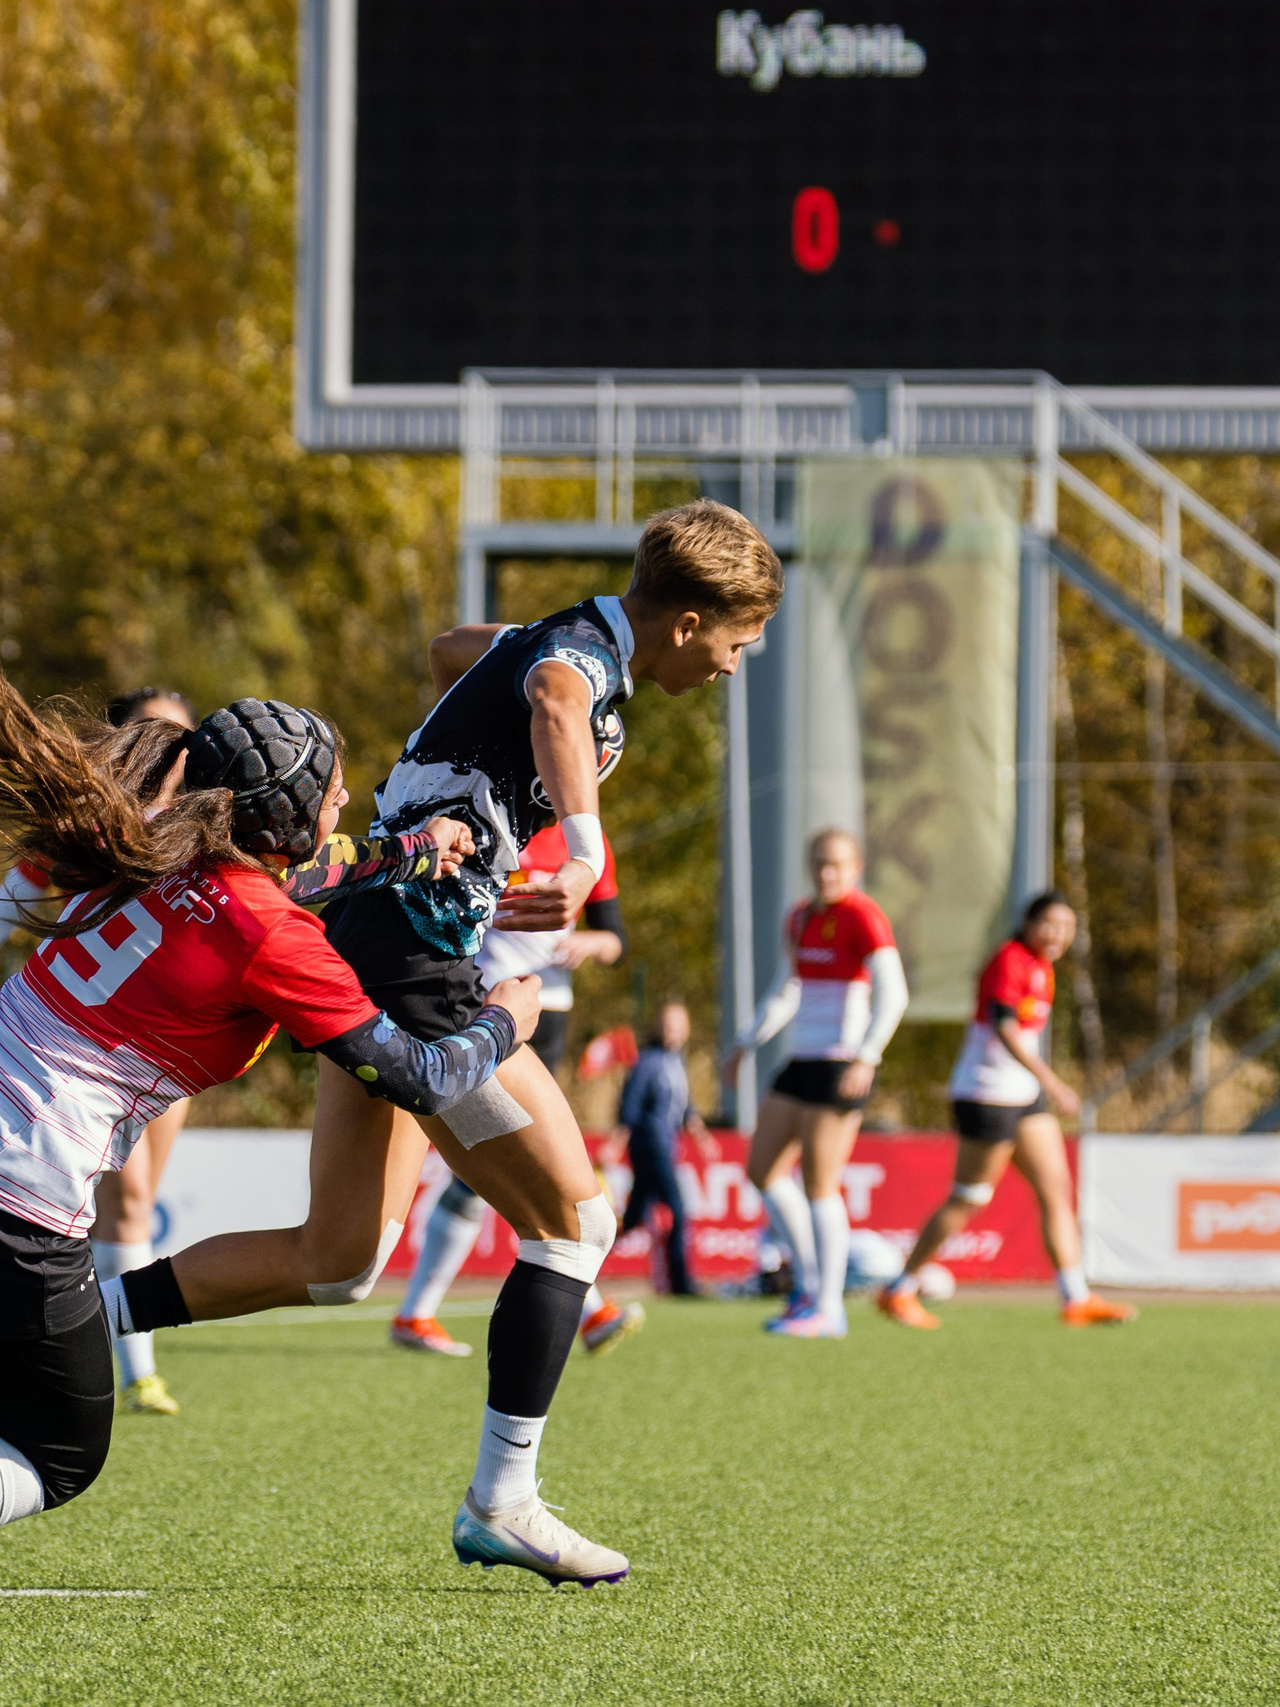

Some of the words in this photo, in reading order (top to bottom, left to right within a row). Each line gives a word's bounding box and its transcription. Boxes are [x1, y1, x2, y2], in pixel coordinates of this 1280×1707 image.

[718, 11, 925, 91] Кубань
[793, 188, 838, 273] 0
[191, 870, 230, 905] КЛУБ
